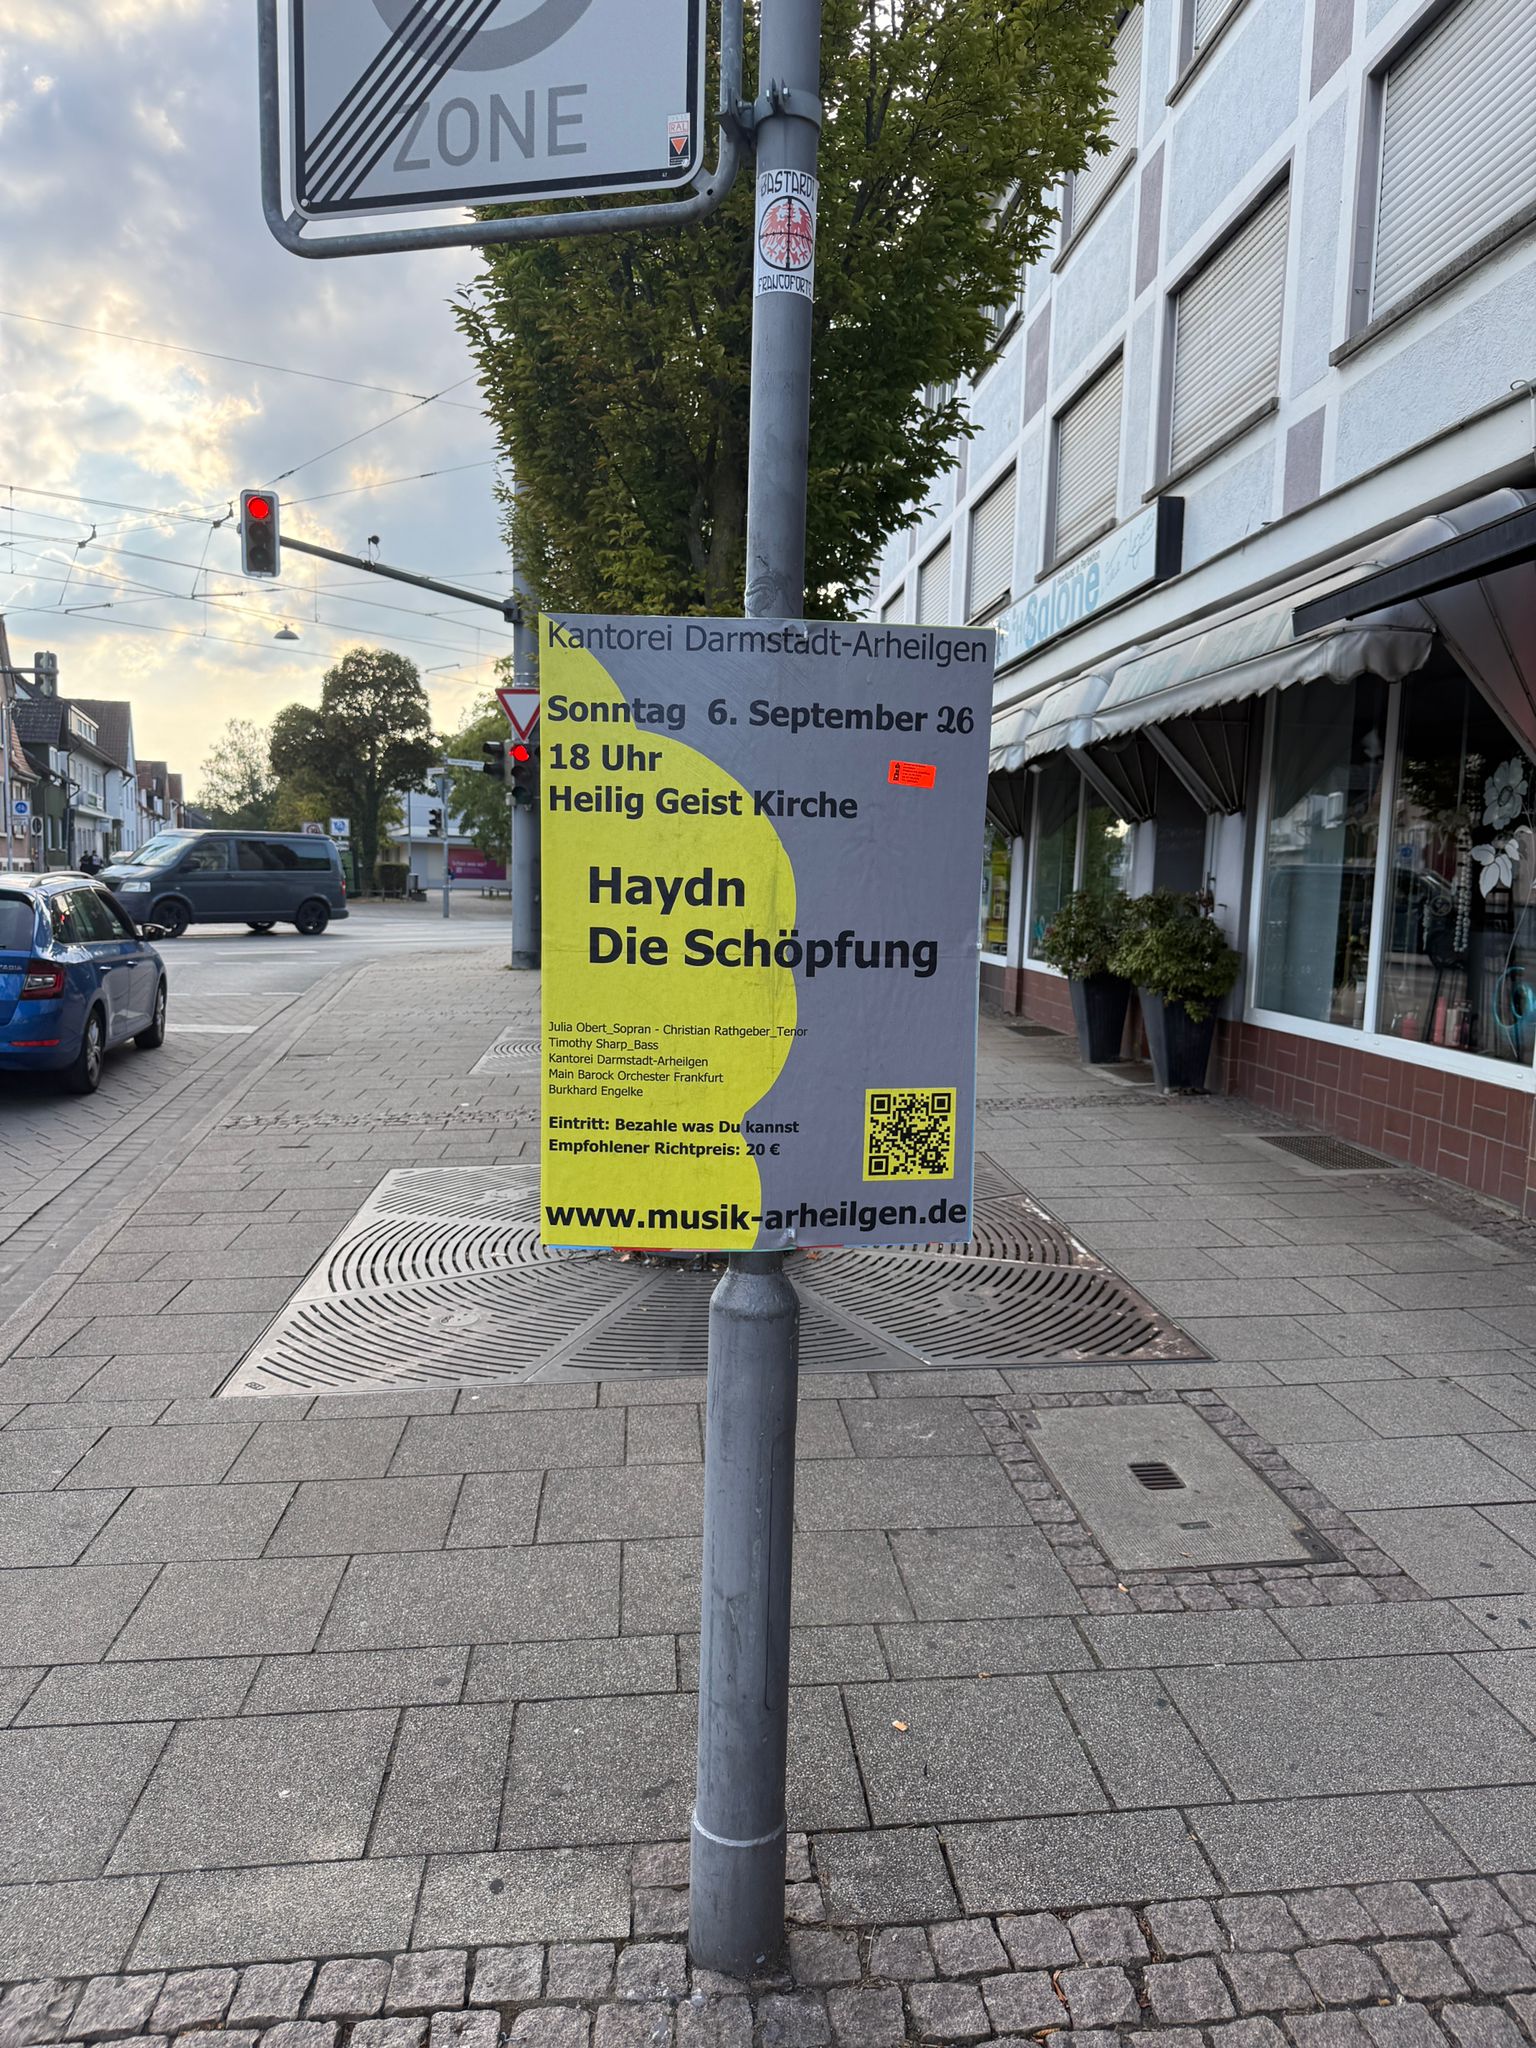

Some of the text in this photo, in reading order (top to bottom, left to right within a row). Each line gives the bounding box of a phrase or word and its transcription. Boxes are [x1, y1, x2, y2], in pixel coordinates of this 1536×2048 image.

[393, 83, 588, 172] ZONE
[548, 622, 672, 651] Kantorei
[687, 626, 986, 666] Darmstadt-Arheilgen
[547, 695, 974, 735] Sonntag 6. September 26
[550, 744, 662, 772] 18 Uhr
[550, 787, 857, 819] Heilig Geist Kirche
[590, 867, 745, 915] Haydn
[590, 927, 938, 977] Die Schöpfung
[549, 1022, 572, 1034] Julia
[577, 1022, 651, 1036] Obert_Sopran
[663, 1024, 710, 1036] Christian
[715, 1025, 808, 1038] Rathgeber_Tenor
[549, 1038, 658, 1052] Timothy Sharp_Bass
[549, 1054, 708, 1068] Kantorei Darmstadt-Arheilgen
[549, 1069, 723, 1083] Main Barock Orchester Frankfurt
[549, 1085, 643, 1099] Burkhard Engelke
[549, 1117, 799, 1134] Eintritt: Bezahle was Du kannst
[549, 1140, 780, 1157] Empfohlener Richtpreis: 20 €
[546, 1199, 966, 1231] www.musik-arheilgen.de
